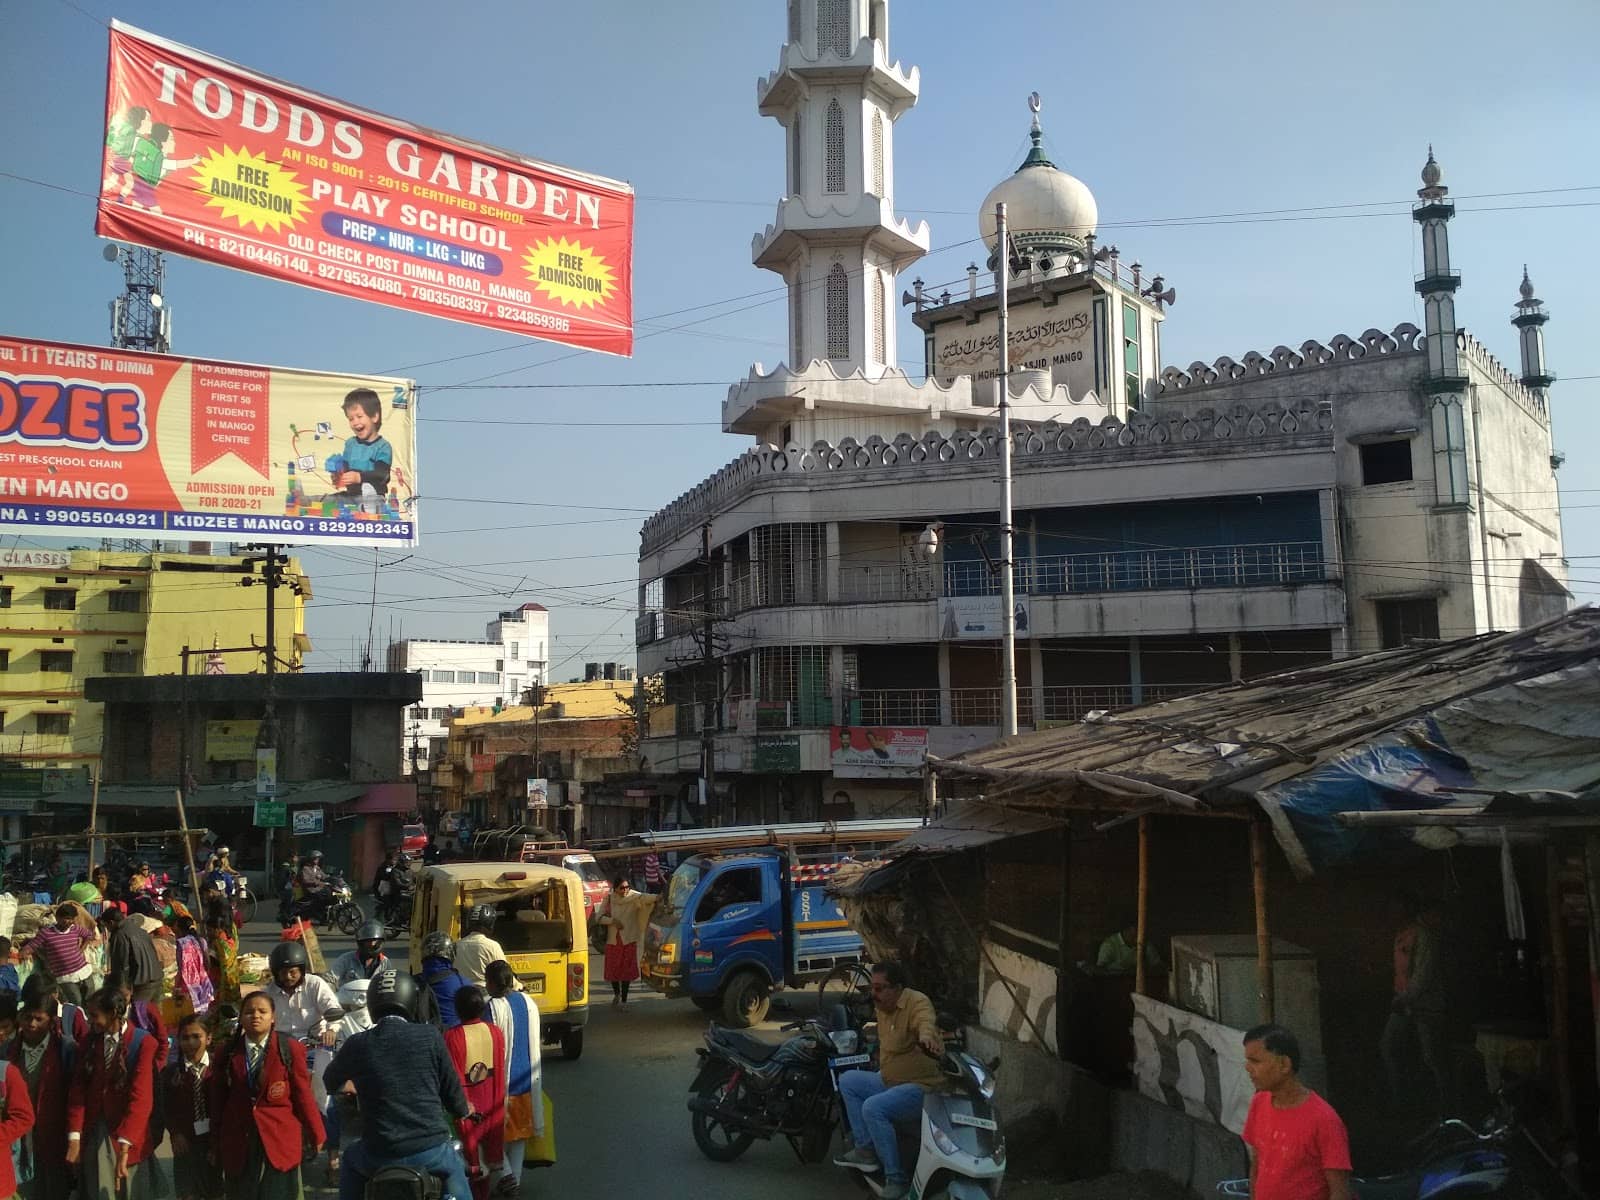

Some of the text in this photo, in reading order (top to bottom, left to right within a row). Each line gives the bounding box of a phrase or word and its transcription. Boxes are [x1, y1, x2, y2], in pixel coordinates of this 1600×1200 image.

[152, 60, 601, 230] TODDS GARDEN
[236, 163, 270, 190] FREE
[210, 177, 293, 215] ADMISSION
[282, 147, 301, 162] AN
[306, 153, 328, 169] ISO
[332, 162, 364, 180] 9001
[378, 175, 409, 193] 2015
[413, 185, 477, 212] CERTIFIED
[480, 204, 526, 226] SCHOOL
[312, 178, 513, 252] PLAY SCHOOL
[184, 228, 206, 247] PH
[342, 219, 377, 242] PREP
[389, 231, 414, 253] NUR
[426, 242, 449, 262] LKG
[460, 249, 486, 270] UKG
[288, 233, 315, 251] OLD
[318, 241, 362, 265] CHECK
[366, 253, 400, 273] POST
[403, 262, 444, 284] DIMNA
[488, 282, 532, 304] MANGO
[558, 252, 584, 272] FREE
[538, 265, 602, 294] ADMISSION
[21, 345, 38, 363] 11
[45, 348, 97, 370] YEARS
[100, 359, 113, 371] IN
[116, 361, 154, 376] DIMNA
[1053, 351, 1083, 366] MANGO
[197, 364, 266, 379] NO ADMISSION
[200, 378, 263, 392] CHARGE FOR
[211, 392, 237, 403] FIRST
[206, 406, 256, 418] STUDENTS
[207, 419, 255, 431] IN MANGO
[211, 433, 251, 444] CENTRE
[19, 454, 86, 467] PRE-SCHOOL
[89, 458, 122, 469] CHAIN
[35, 478, 129, 501] MANGO
[186, 482, 275, 497] ADMISSION OPEN
[199, 497, 262, 509] FOR 2020-21
[46, 510, 157, 526] 9905504921
[173, 514, 238, 529] KIDZEE
[243, 517, 305, 532] MANGO
[318, 522, 410, 535] 8292982345
[4, 552, 68, 565] CLASSES
[801, 891, 811, 922] SST
